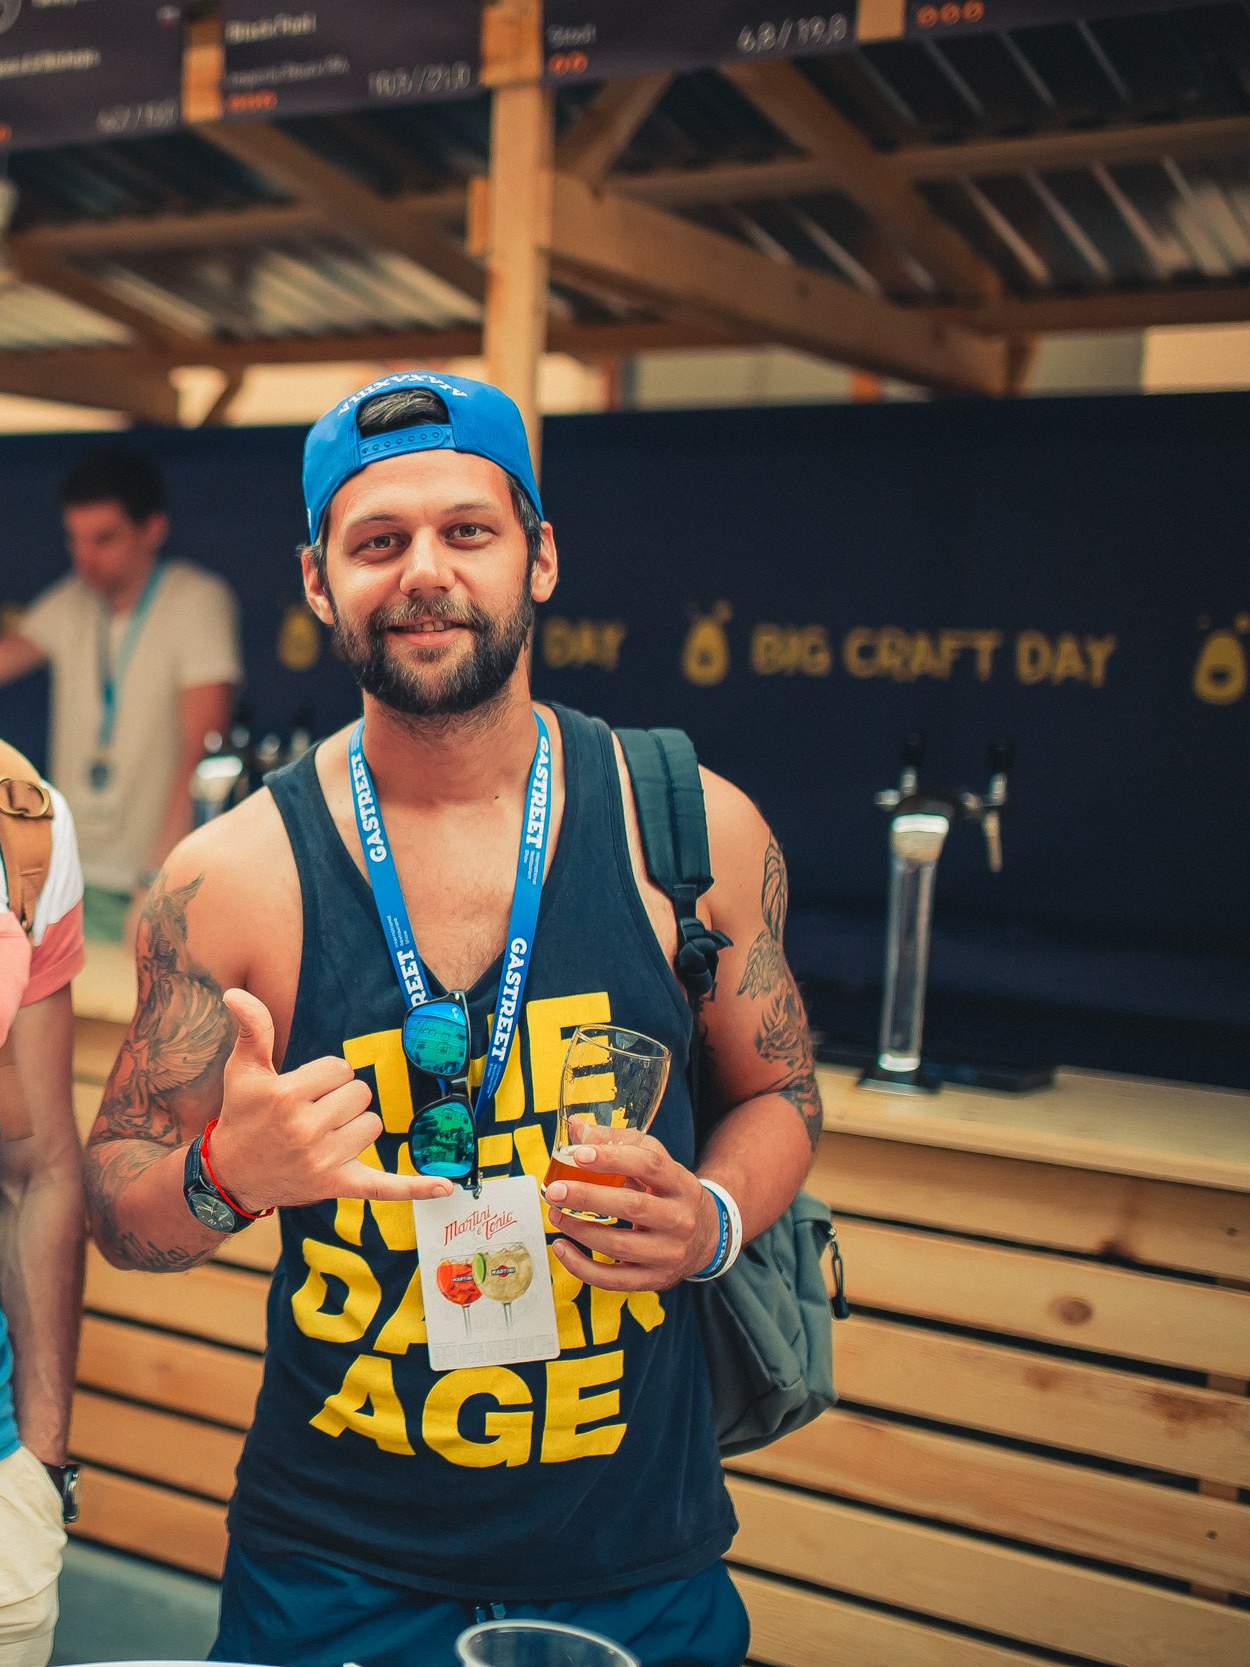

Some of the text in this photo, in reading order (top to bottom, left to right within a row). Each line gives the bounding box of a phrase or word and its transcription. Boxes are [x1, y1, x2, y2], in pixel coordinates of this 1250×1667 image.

[544, 617, 626, 671] DAY
[752, 624, 1115, 688] BIG CRAFT DAY
[351, 752, 385, 862] GASTREET
[525, 735, 550, 850] GASTREET
[491, 937, 528, 1062] GASTREET
[342, 991, 616, 1134] THE
[444, 1205, 491, 1247] Martini
[481, 1209, 518, 1240] Tonic
[308, 1350, 628, 1469] AGE
